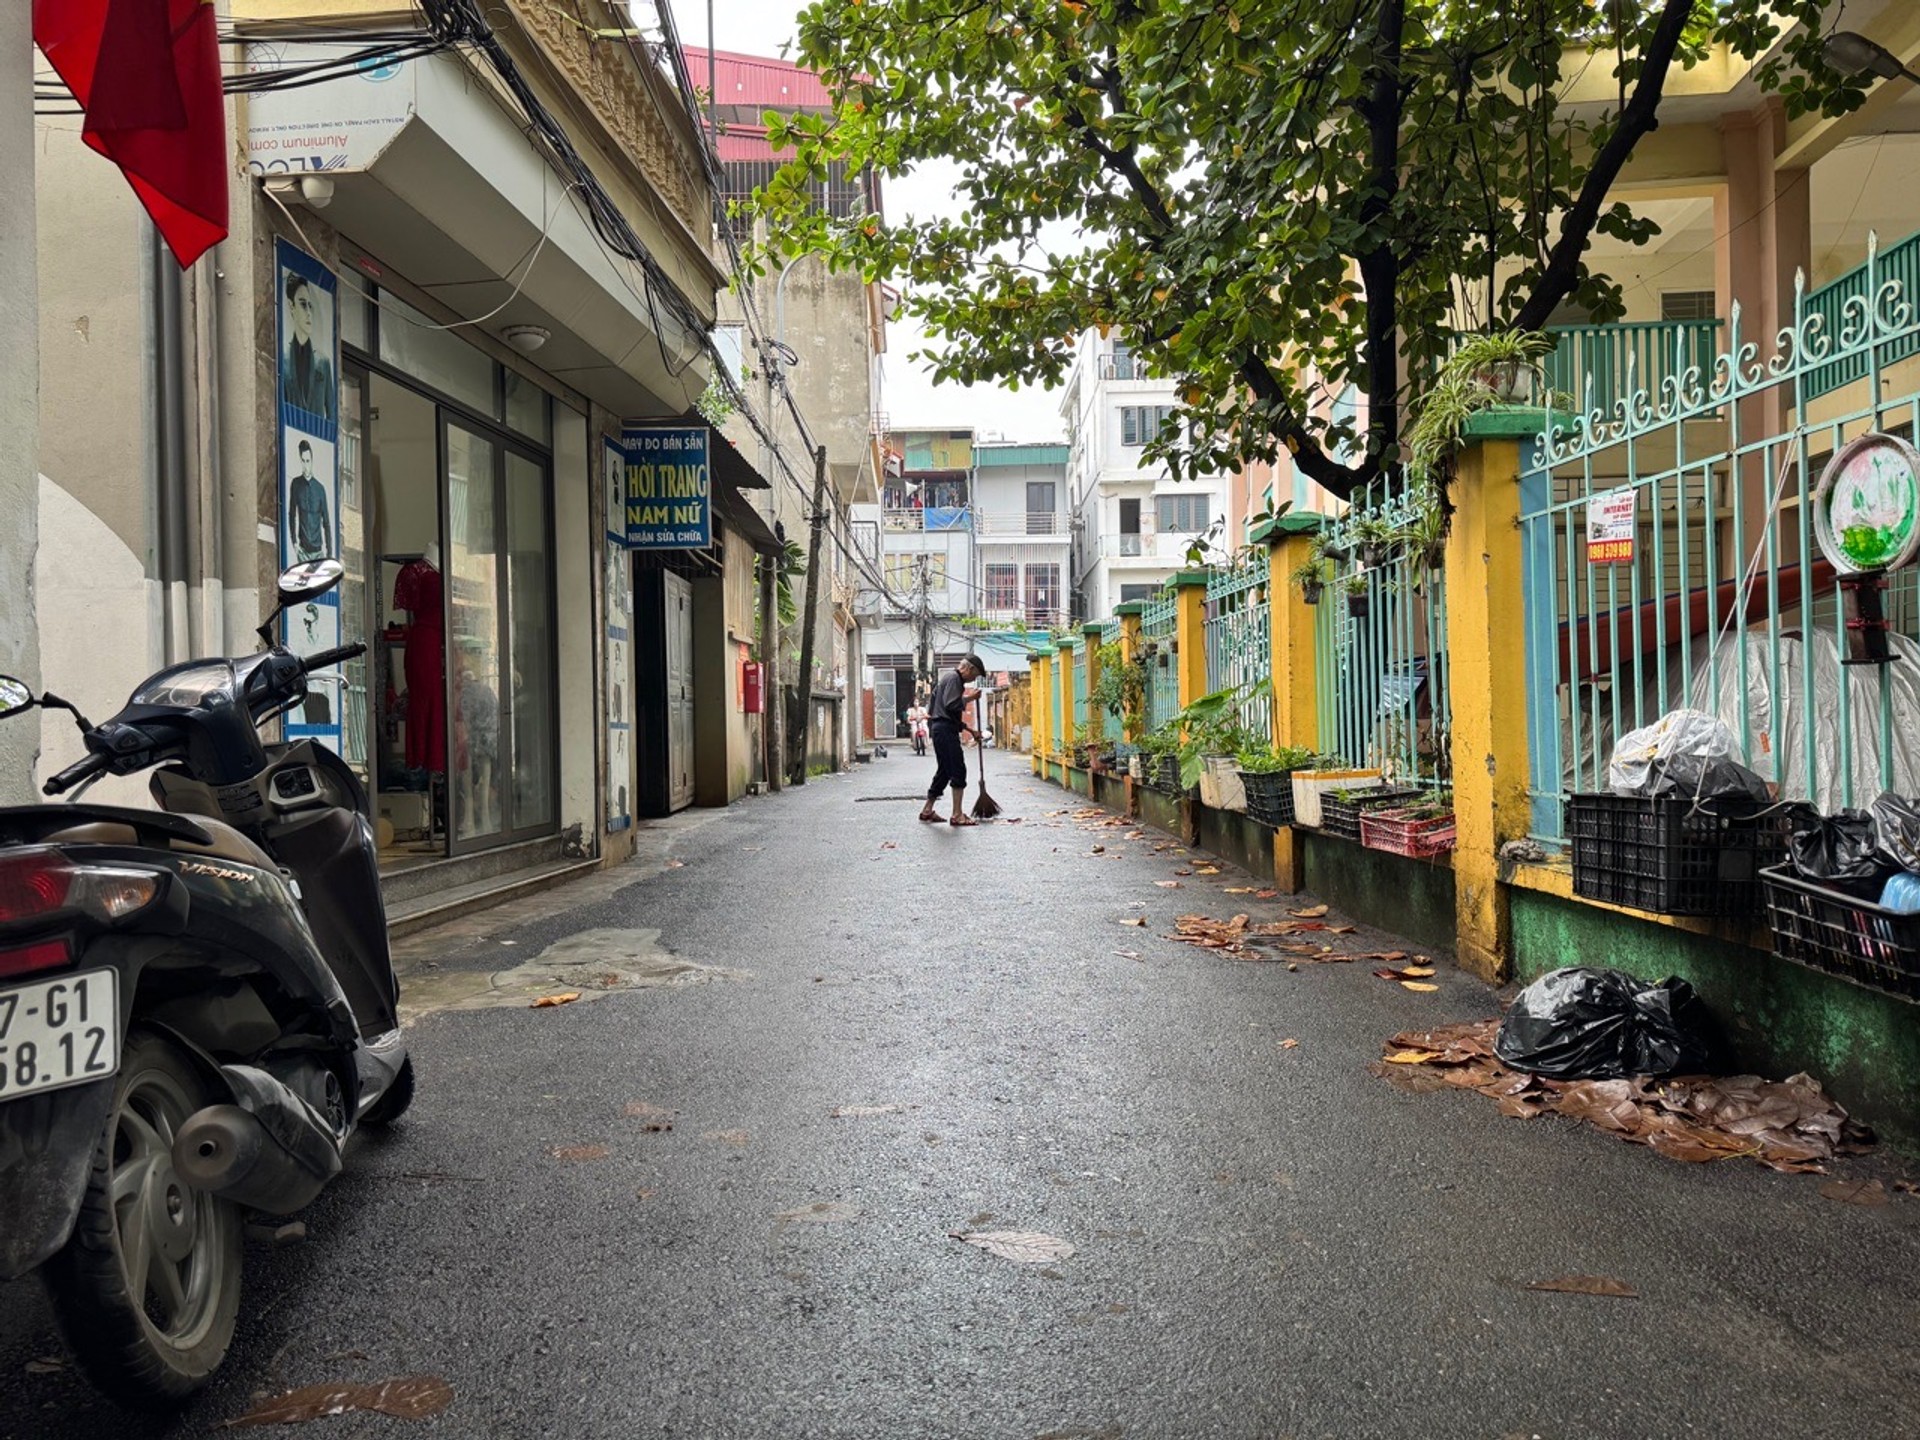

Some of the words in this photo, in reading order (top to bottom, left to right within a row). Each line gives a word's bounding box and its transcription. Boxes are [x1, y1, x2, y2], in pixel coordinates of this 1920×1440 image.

[288, 122, 319, 130] DIRECTION
[248, 139, 278, 151] com
[282, 135, 348, 150] Aluminum
[645, 437, 660, 450] ĐO
[663, 434, 682, 450] BÁN
[659, 464, 707, 498] TRANG
[627, 505, 669, 525] NAM
[674, 501, 703, 525] NỮ
[1603, 502, 1633, 514] INTERNET
[628, 530, 654, 544] NHẬN
[677, 529, 702, 542] CHỮA
[177, 859, 255, 884] VISION
